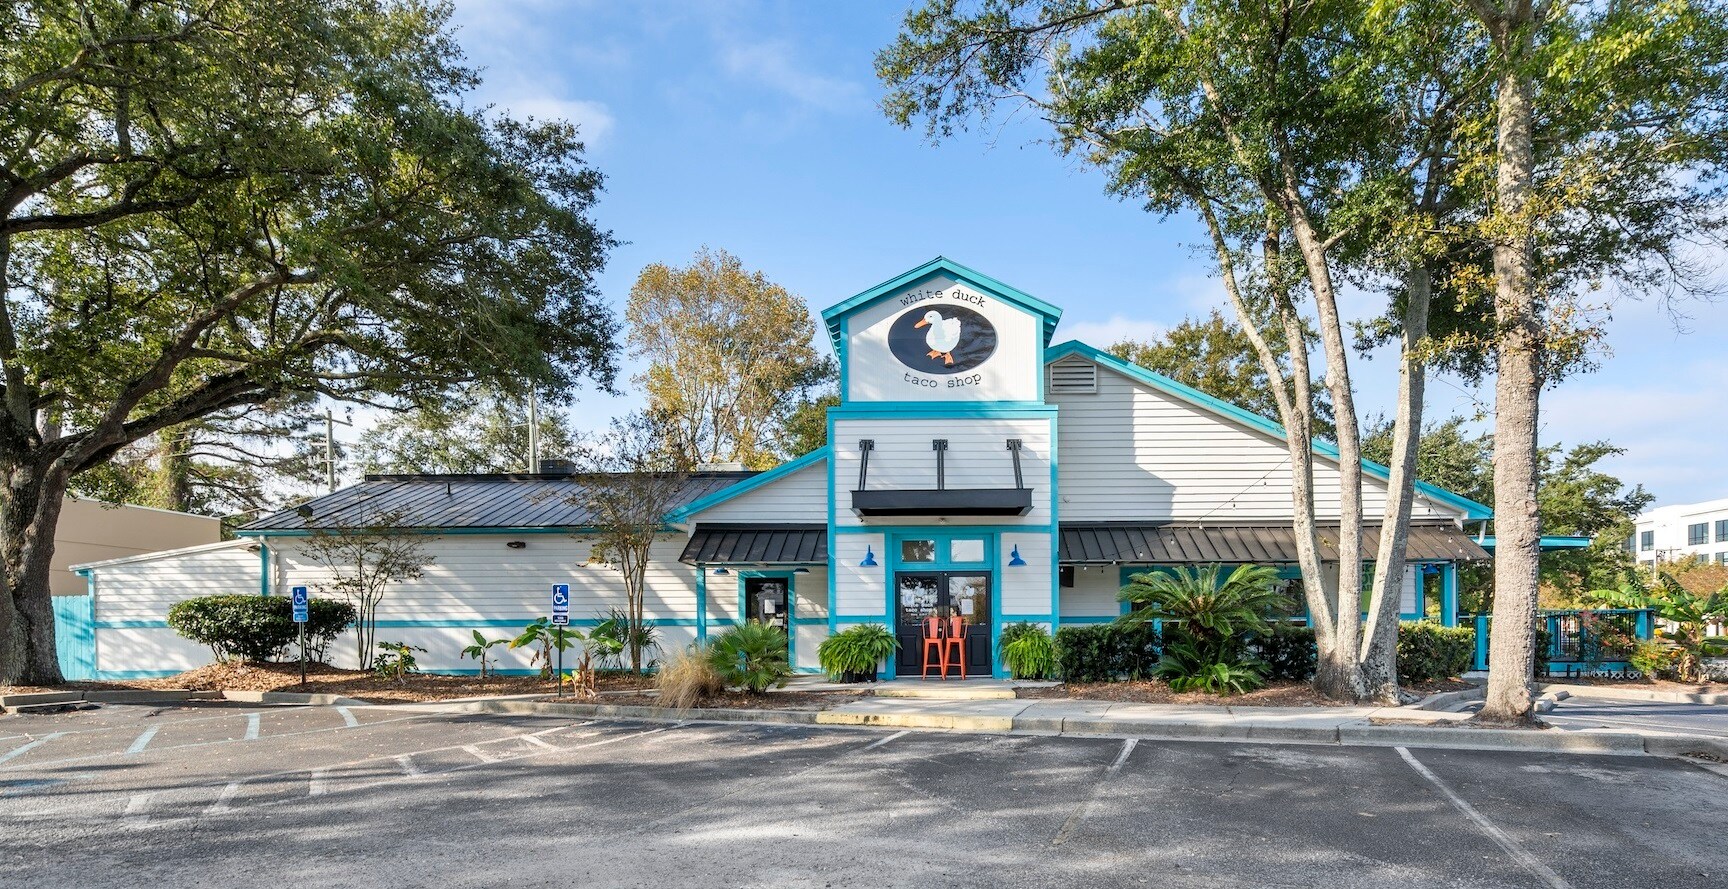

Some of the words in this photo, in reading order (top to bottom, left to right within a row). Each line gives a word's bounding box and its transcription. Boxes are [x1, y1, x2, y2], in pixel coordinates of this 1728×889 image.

[900, 290, 943, 306] white
[952, 289, 986, 308] duck
[904, 372, 938, 388] taco
[947, 373, 982, 388] shop
